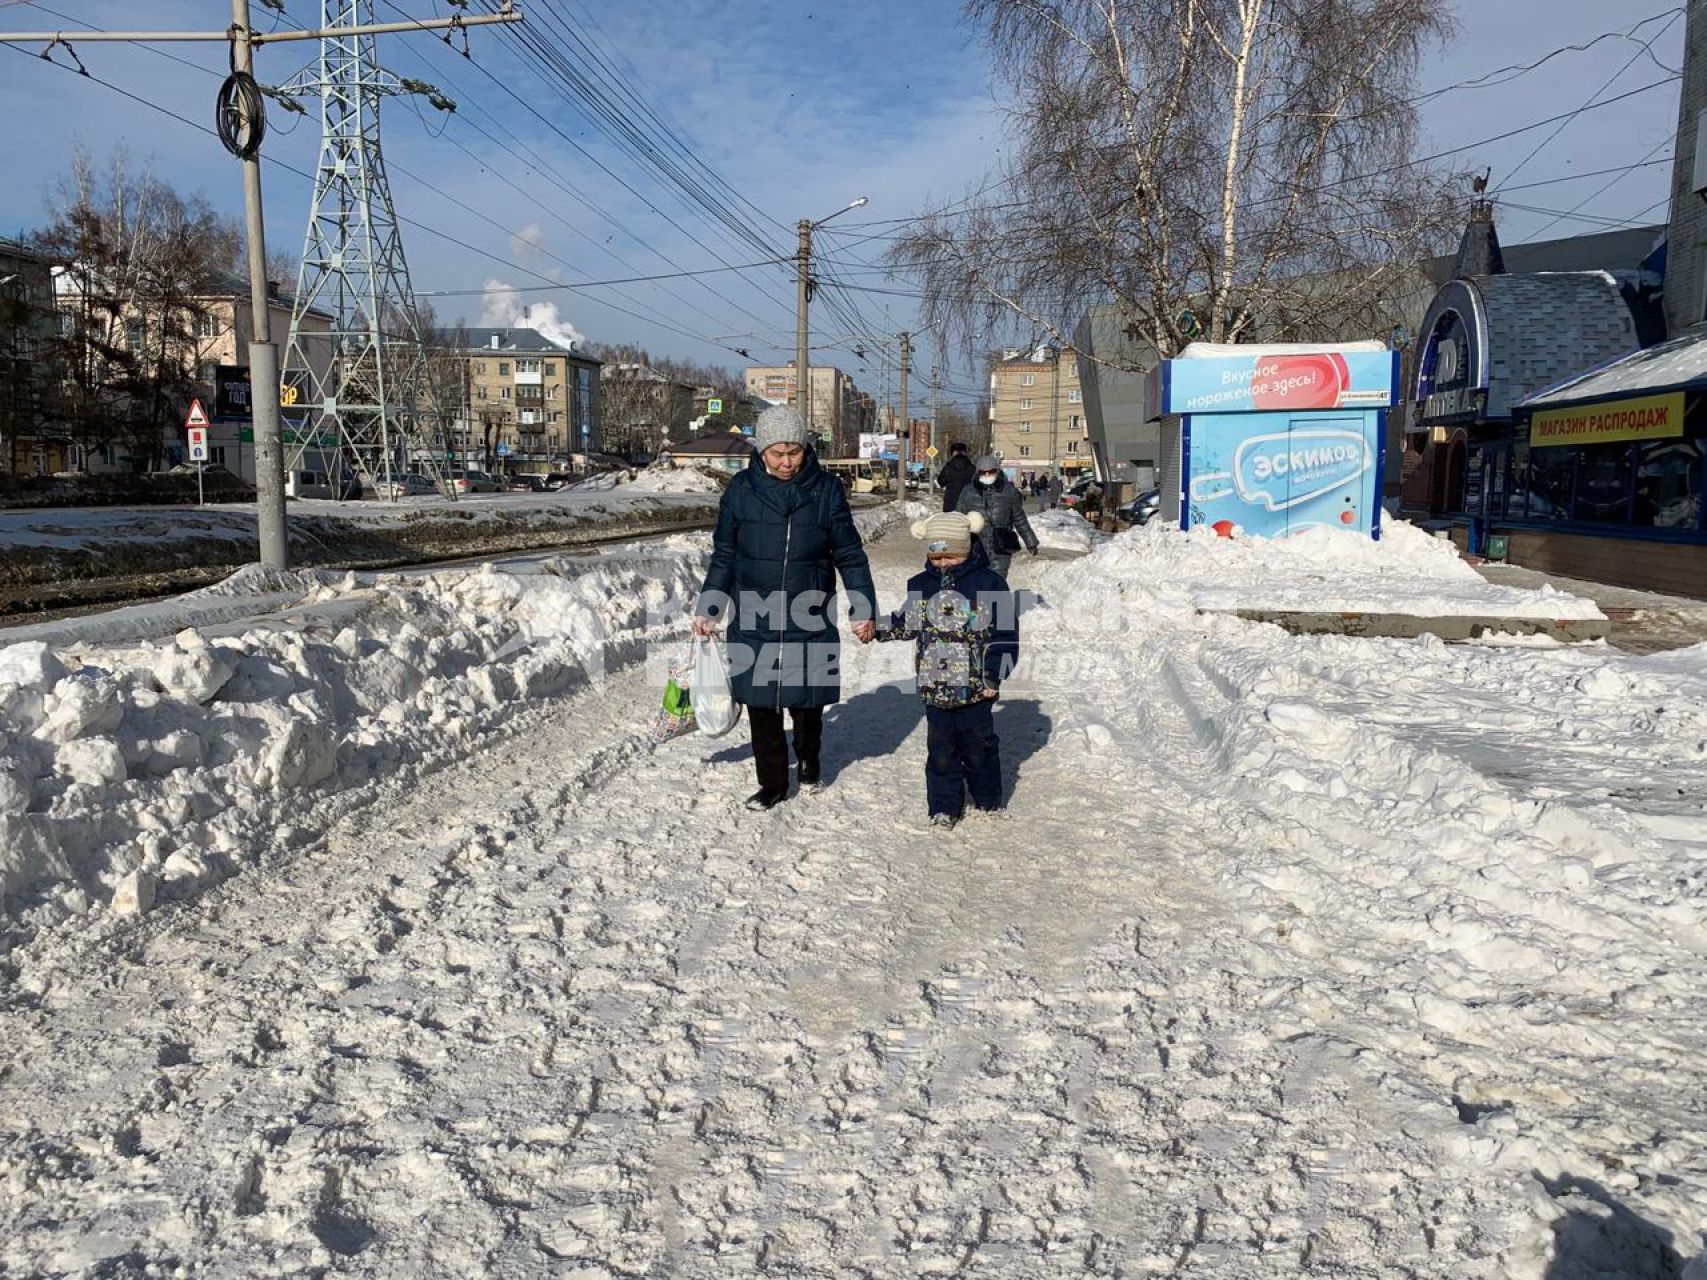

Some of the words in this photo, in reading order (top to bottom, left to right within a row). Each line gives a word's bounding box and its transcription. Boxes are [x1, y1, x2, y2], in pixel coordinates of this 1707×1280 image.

[1187, 383, 1269, 409] мороженое
[1272, 369, 1316, 396] здесь!
[1221, 364, 1279, 385] Вкусное
[1540, 417, 1587, 436] МАГАЗИН
[1589, 406, 1669, 432] РАСПРОДАЖ
